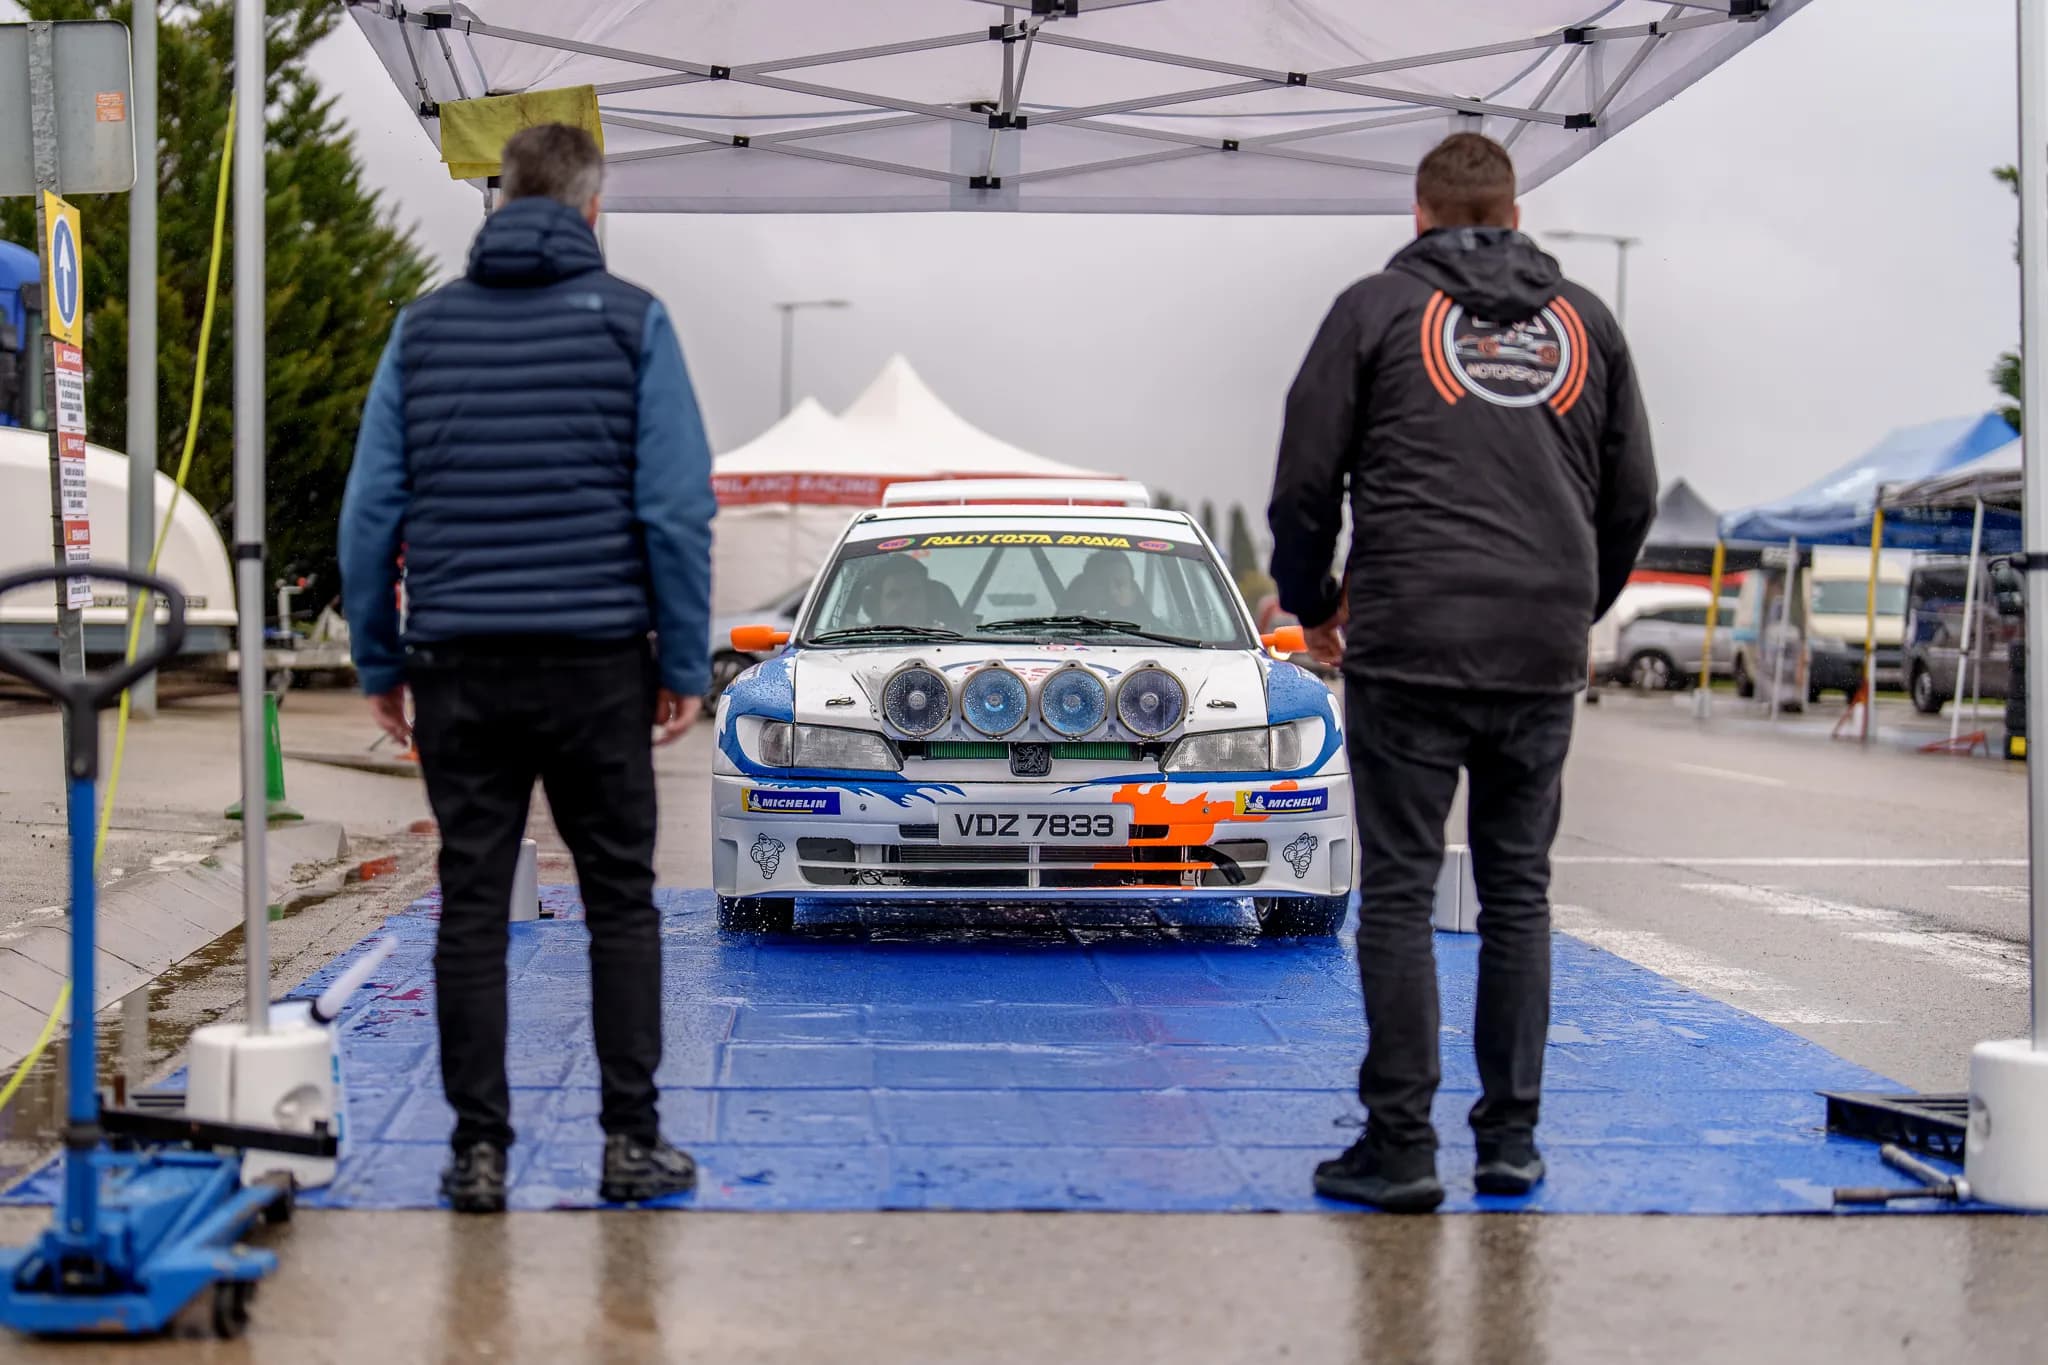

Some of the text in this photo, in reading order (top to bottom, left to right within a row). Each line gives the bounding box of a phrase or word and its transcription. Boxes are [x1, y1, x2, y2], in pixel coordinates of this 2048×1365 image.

[921, 533, 1131, 548] RALLY COSTA BRAVA
[762, 797, 828, 809] MICHELIN
[1267, 795, 1322, 808] MICHELIN
[955, 813, 1114, 837] VDZ 7833
